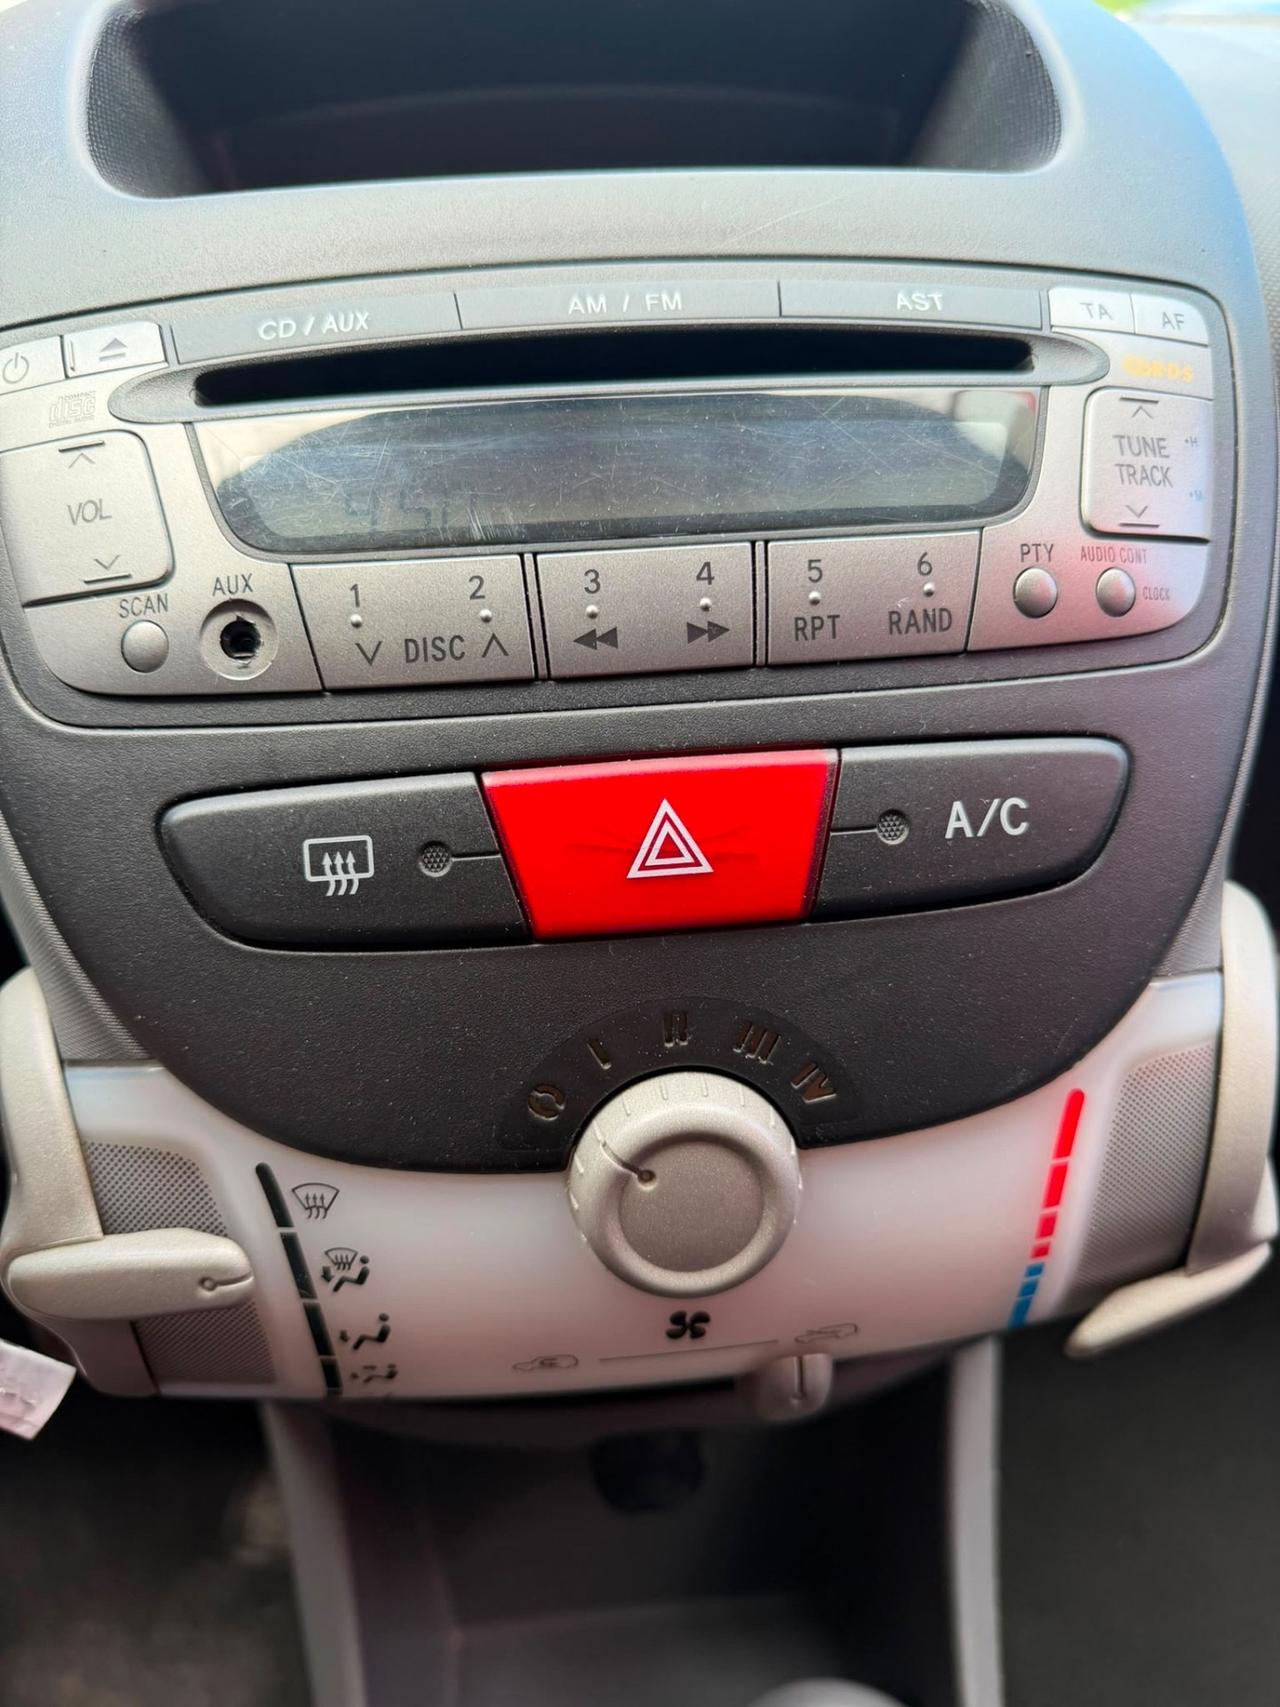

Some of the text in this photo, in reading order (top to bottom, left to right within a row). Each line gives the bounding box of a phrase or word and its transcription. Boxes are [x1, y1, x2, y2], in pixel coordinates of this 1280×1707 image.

[568, 295, 607, 315] AM
[645, 290, 683, 312] FM
[896, 292, 943, 311] AST
[1080, 302, 1113, 321] TA
[258, 319, 297, 341] CD
[322, 310, 370, 334] AUX
[1162, 311, 1185, 331] AF
[1112, 434, 1170, 458] TUNE
[1114, 463, 1174, 488] TRACK
[66, 498, 112, 526] VOL
[917, 552, 933, 576] 6
[1020, 543, 1054, 563] PTY
[1080, 546, 1149, 565] AUDIO CONT
[584, 569, 601, 594] 3
[696, 561, 715, 585] 4
[807, 559, 823, 583] 5
[212, 573, 254, 597] AUX
[350, 583, 360, 608] 1
[468, 575, 486, 600] 2
[1142, 586, 1171, 601] CLOCK
[118, 593, 169, 619] SCAN
[794, 615, 840, 642] RPT
[888, 608, 953, 635] RAND
[404, 635, 466, 663] DISC
[945, 797, 1030, 839] A/C
[790, 1058, 837, 1104] IV
